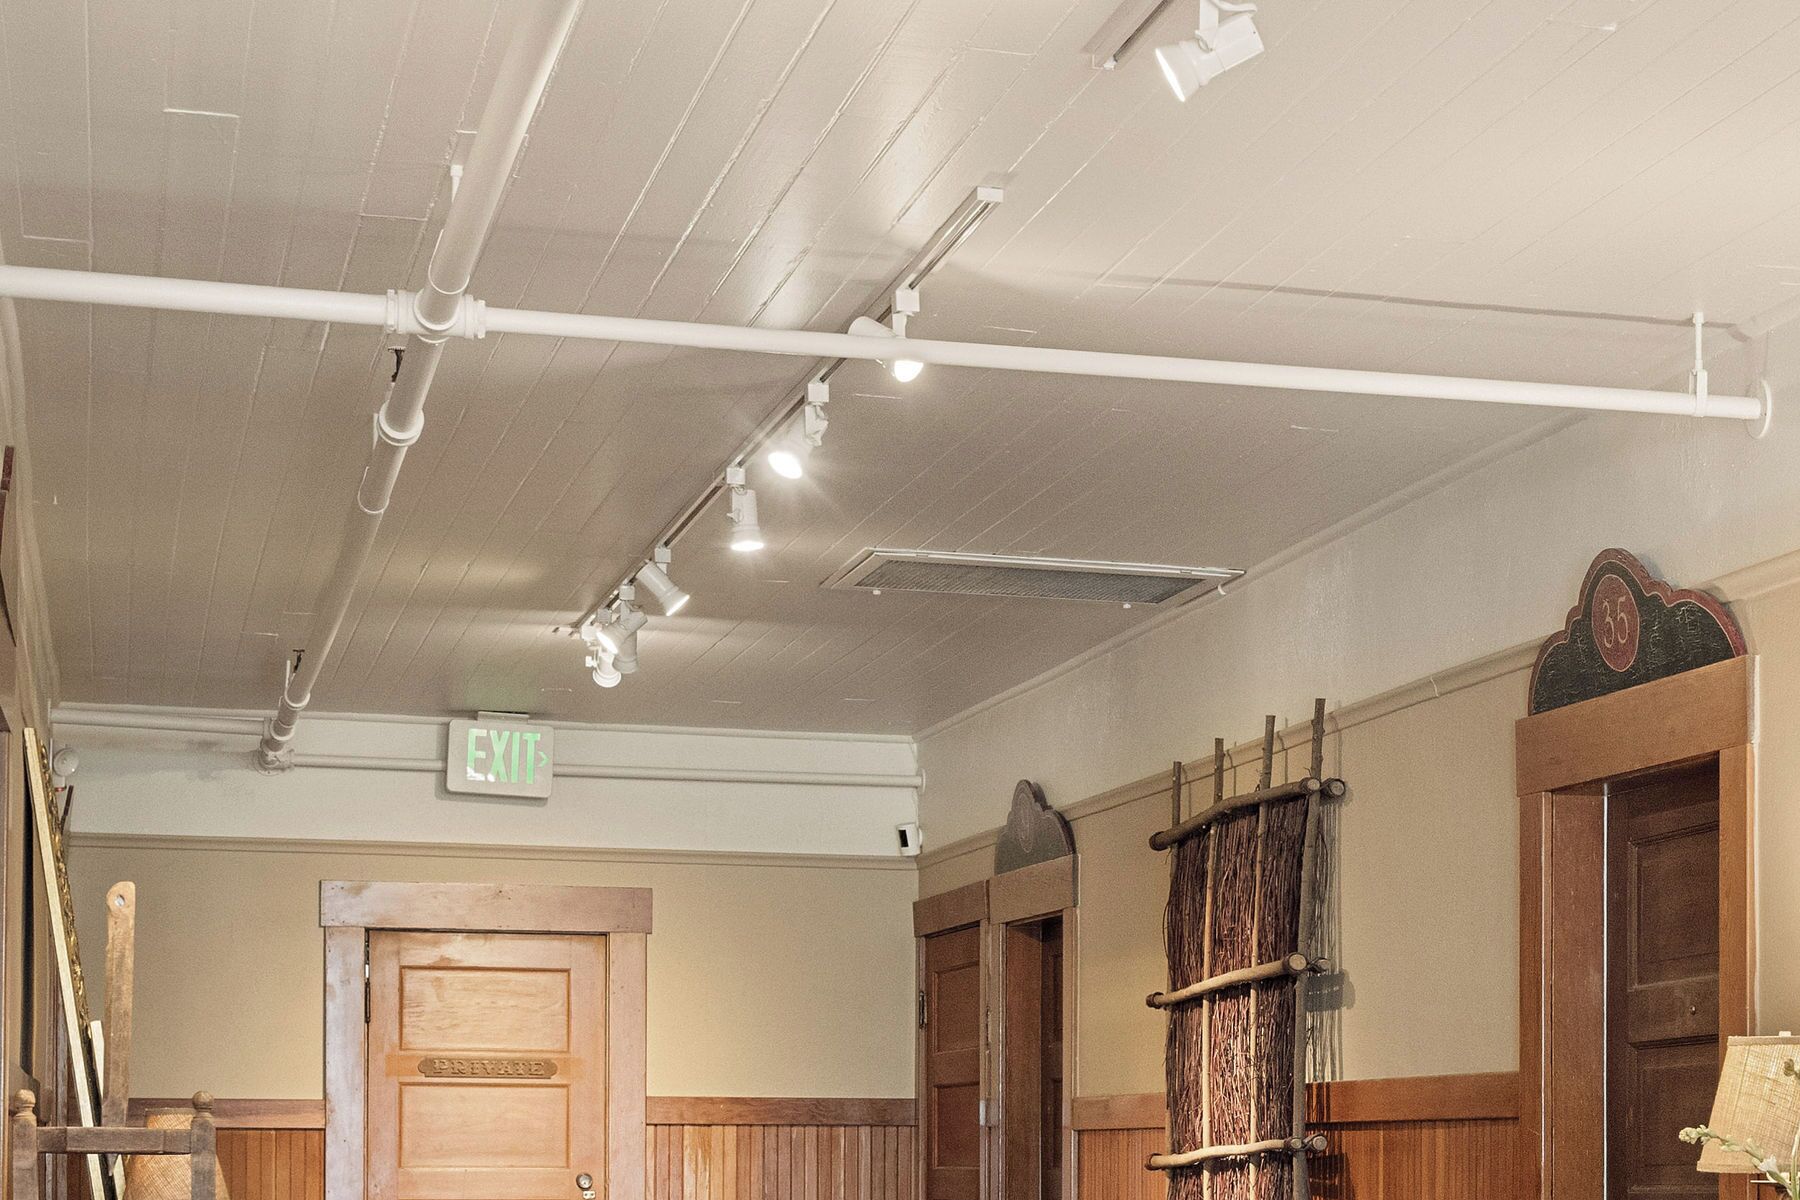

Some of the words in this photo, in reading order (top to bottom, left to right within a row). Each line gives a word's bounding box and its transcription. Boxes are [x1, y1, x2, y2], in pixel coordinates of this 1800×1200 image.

[1601, 595, 1629, 649] 35
[466, 727, 541, 785] EXIT
[432, 1058, 546, 1076] PRIVATE
